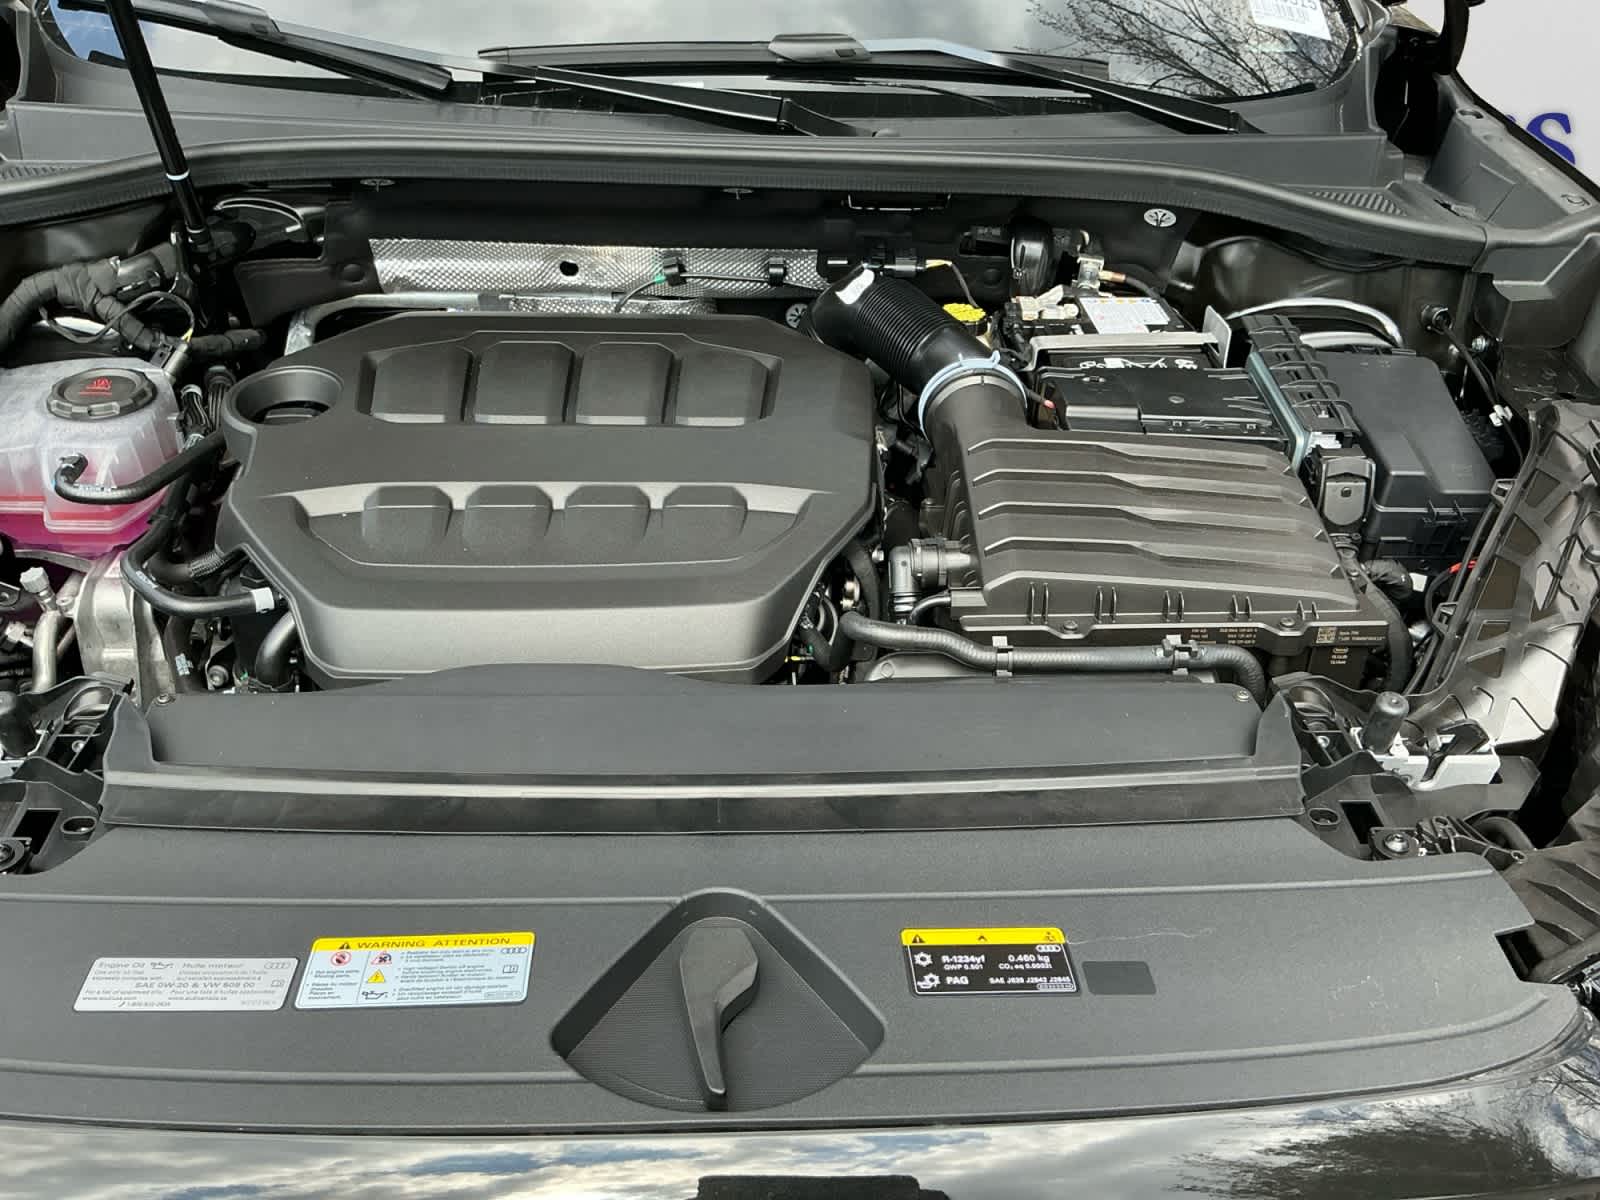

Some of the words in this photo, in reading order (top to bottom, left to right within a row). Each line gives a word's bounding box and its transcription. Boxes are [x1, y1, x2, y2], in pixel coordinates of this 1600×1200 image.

[358, 940, 425, 949] WARNING
[432, 937, 511, 947] ATTENTION
[1036, 954, 1050, 964] kg
[945, 976, 969, 985] PAG
